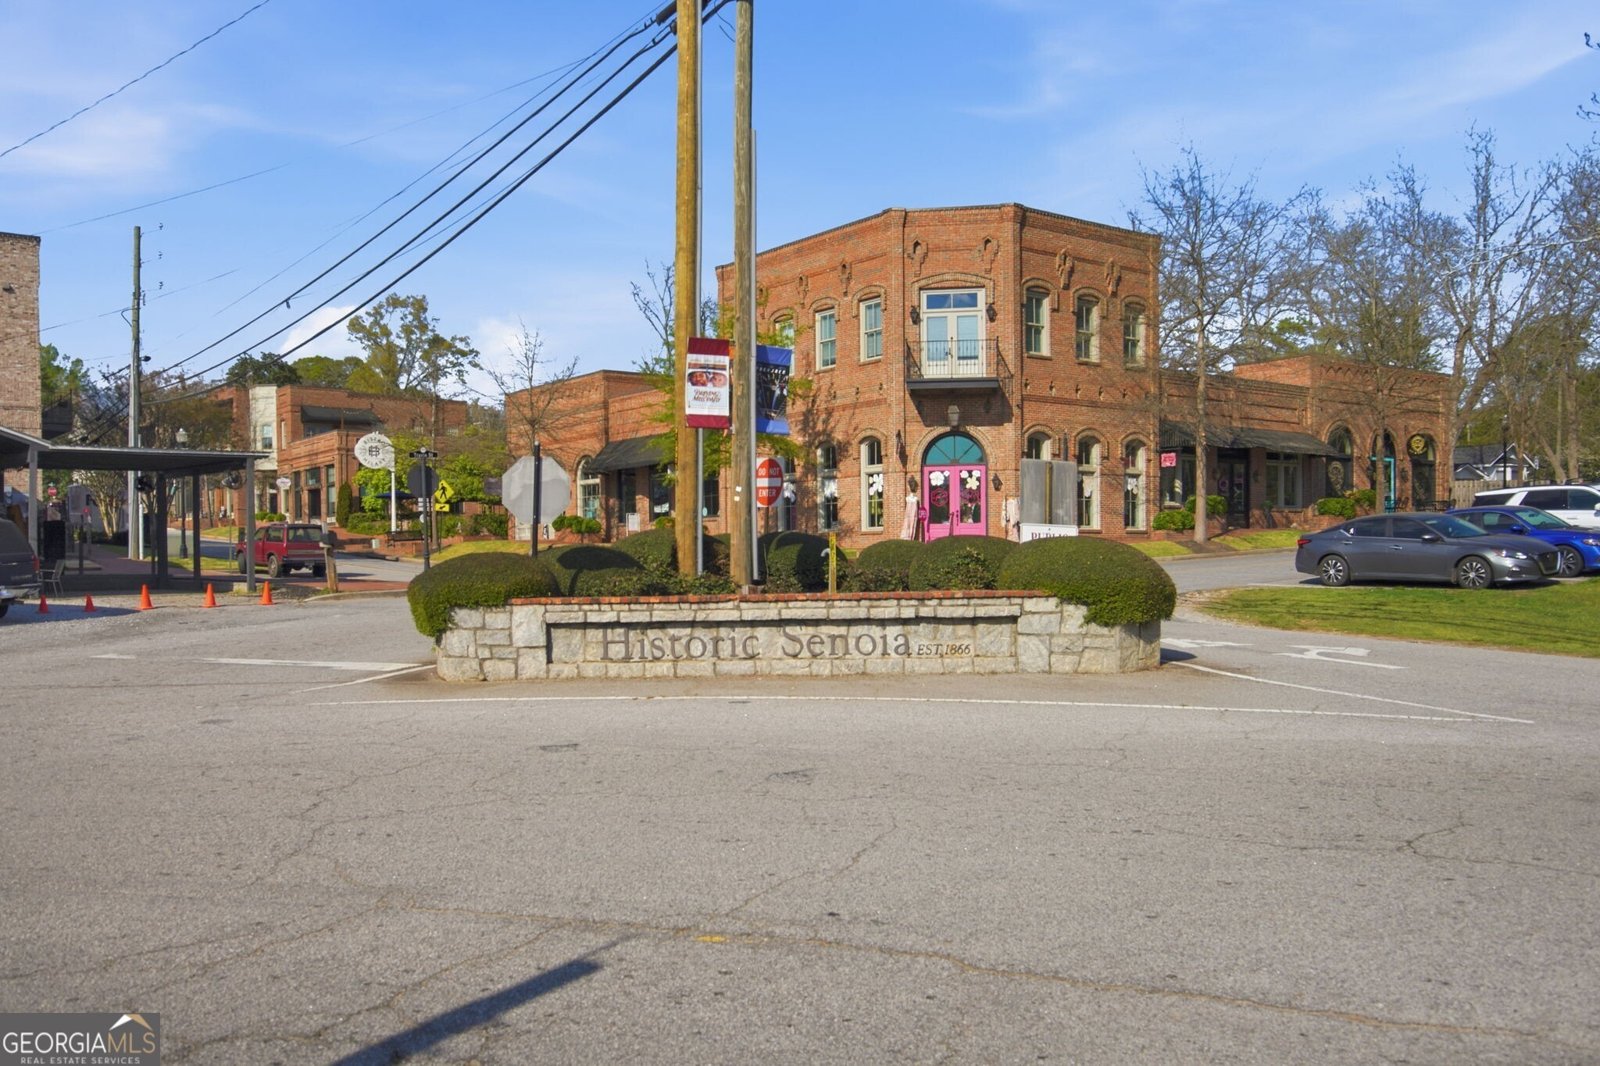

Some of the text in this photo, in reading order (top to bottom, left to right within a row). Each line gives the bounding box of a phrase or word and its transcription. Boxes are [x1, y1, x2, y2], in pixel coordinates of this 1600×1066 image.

[758, 468, 780, 476] DO NOT
[758, 488, 777, 497] ENTER
[600, 626, 760, 660] Historic
[781, 624, 912, 658] Senoia
[944, 643, 971, 656] 1866
